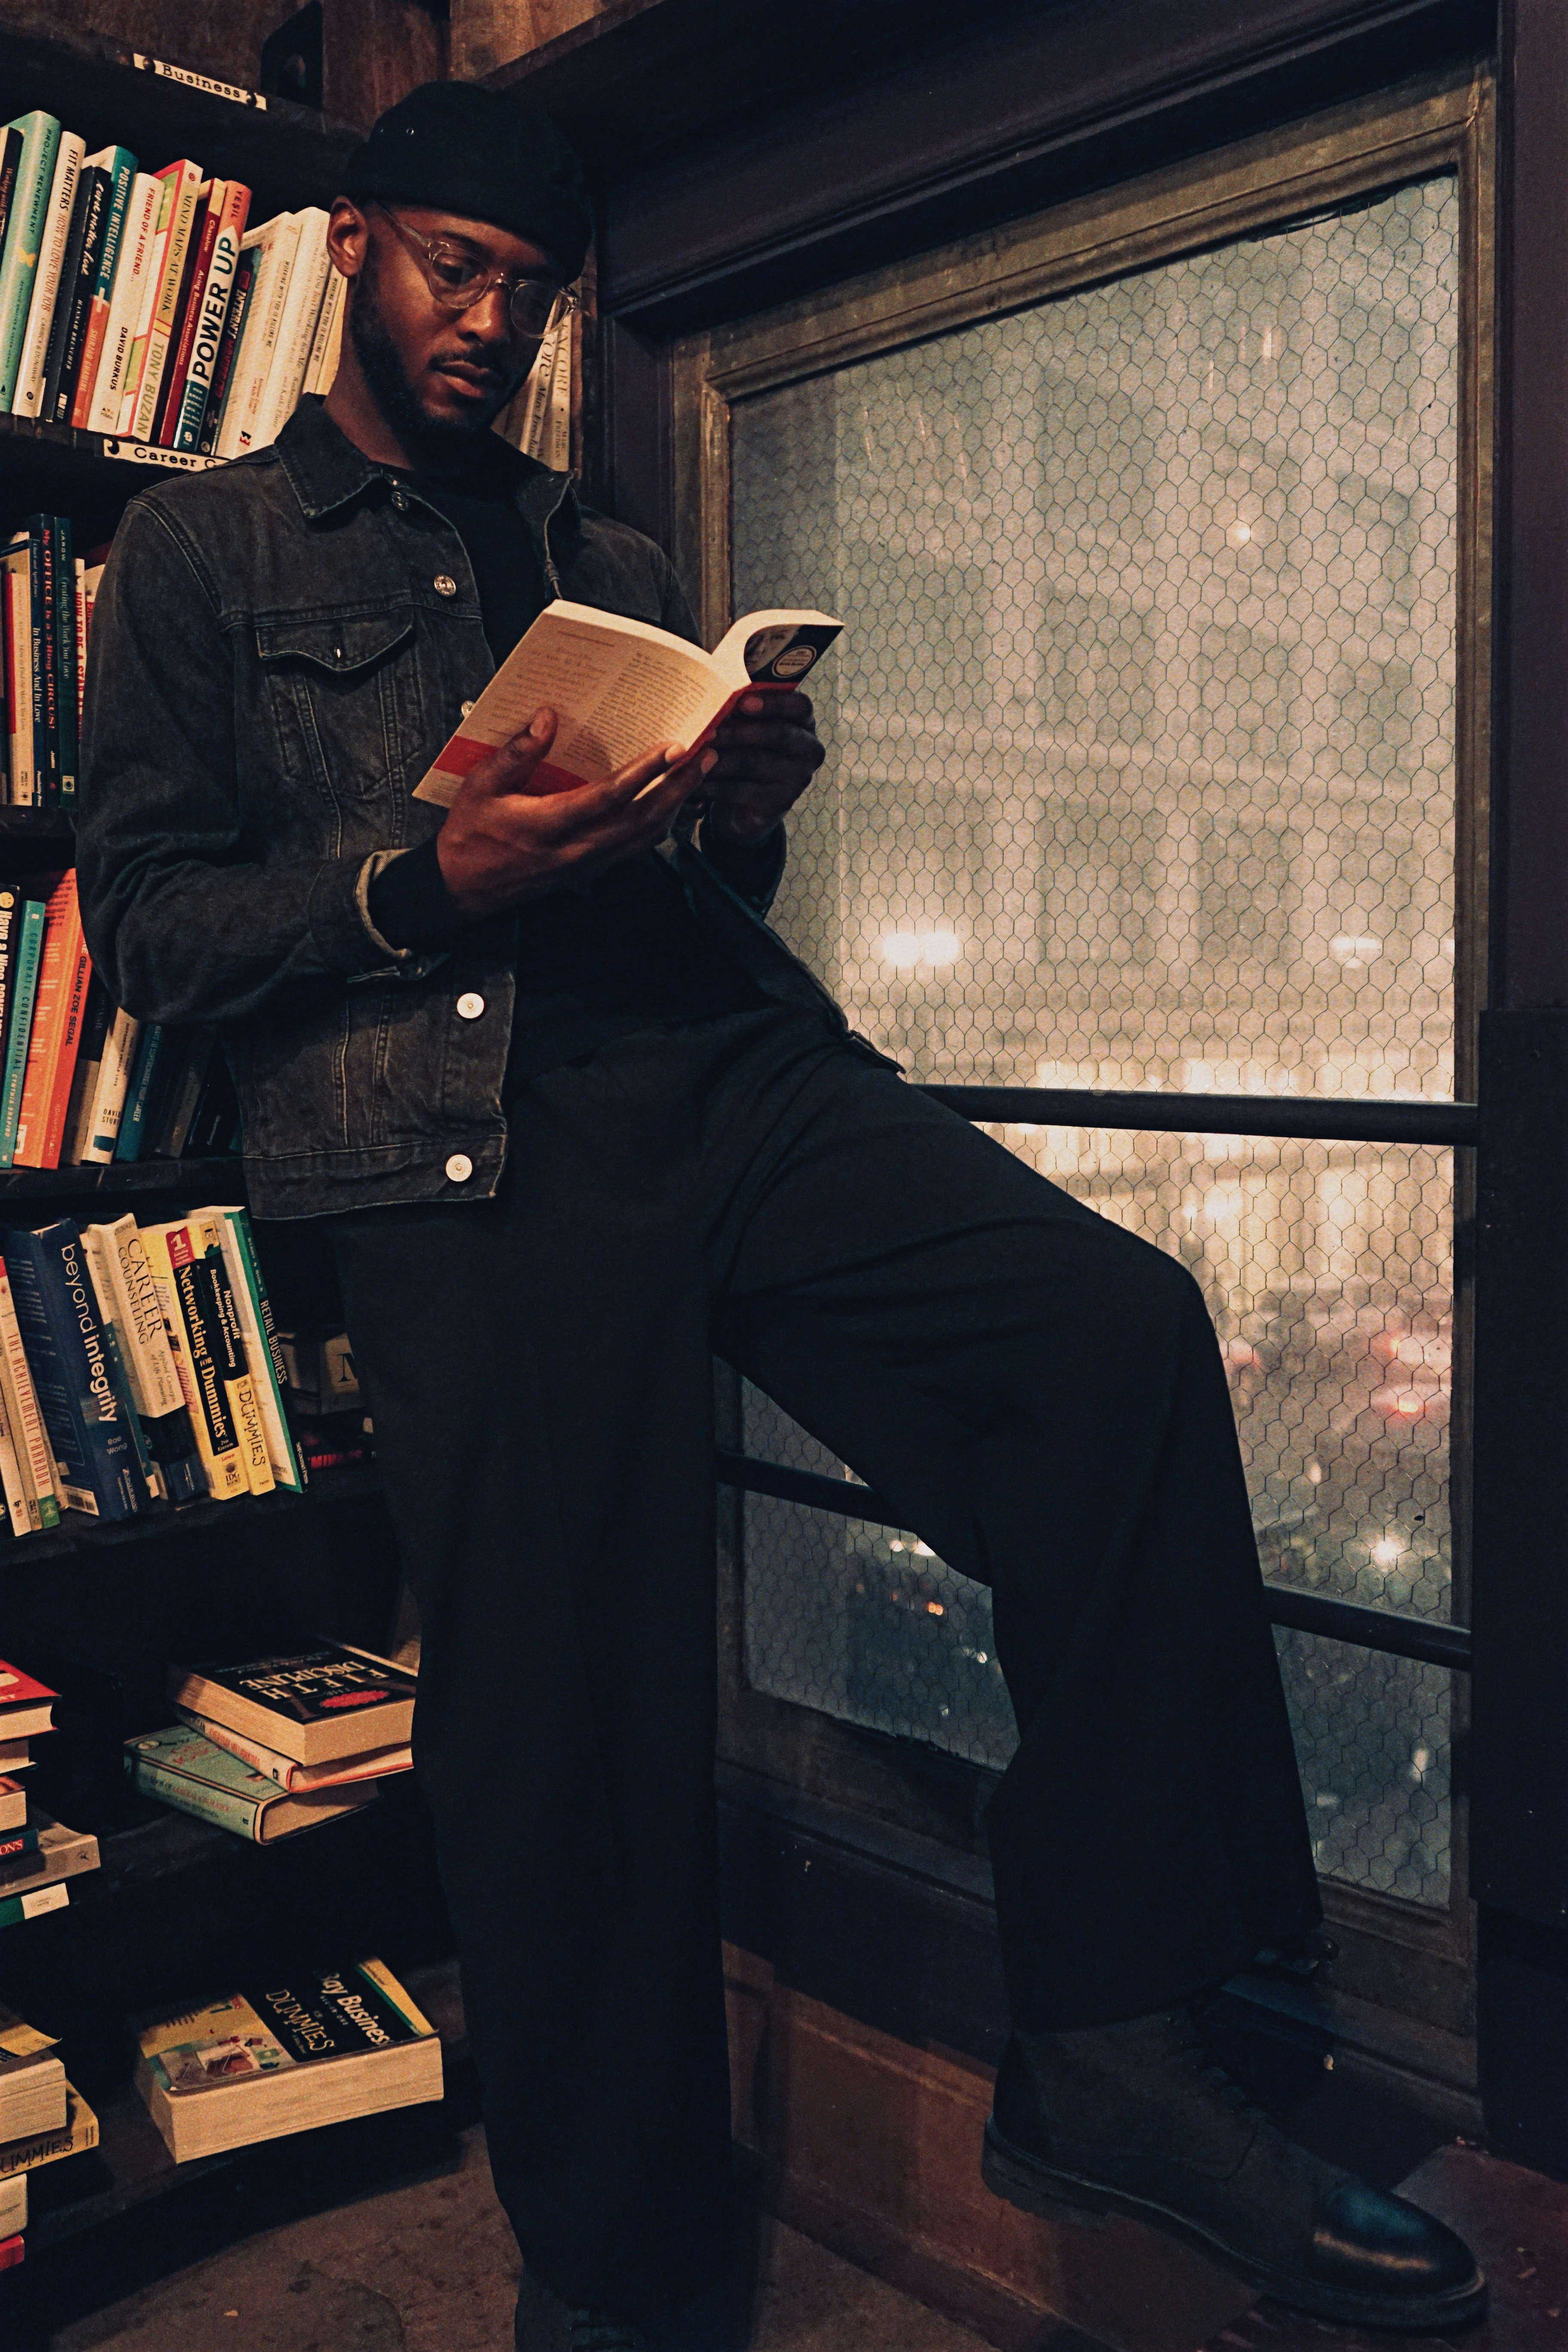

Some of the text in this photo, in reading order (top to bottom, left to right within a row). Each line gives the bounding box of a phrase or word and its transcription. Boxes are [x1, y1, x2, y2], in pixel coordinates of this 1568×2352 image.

[163, 64, 240, 98] Business
[30, 128, 52, 234] PROJECT RENEWMENT
[68, 149, 78, 165] FIT
[59, 166, 75, 210] MATTERS
[143, 187, 155, 220] FRIEND
[52, 235, 64, 247] TO
[54, 213, 67, 236] HOW
[99, 166, 131, 280] POSITIVE INTELLIGENCE
[140, 221, 149, 232] OF
[203, 219, 216, 253] Chasalow
[49, 247, 61, 271] LOVE
[162, 195, 193, 312] MIND MAPS AT WORK
[41, 293, 53, 312] JOB
[46, 271, 58, 294] YOUR
[178, 269, 204, 366] Acing Business Associations
[192, 282, 228, 381] POWER
[213, 237, 236, 275] UP
[110, 326, 128, 390] DAVID BURKUS
[137, 342, 165, 434] TONY BUZAN
[134, 447, 196, 467] Career
[43, 529, 50, 545] My
[43, 550, 52, 605] OFFICE
[59, 576, 70, 679] Creating the Work You Love
[33, 627, 42, 722] In Business And In Love
[46, 673, 55, 728] CIRCUS!
[0, 910, 12, 940] Have
[76, 956, 86, 993] GILLIAN
[13, 932, 38, 1070] CORPORATE CONFIDENTIAL
[71, 994, 80, 1014] ZOE
[65, 1016, 76, 1047] SEGAL
[4, 1073, 18, 1138] CYNTHIA SHAPIRO
[132, 1100, 143, 1122] CAREER
[119, 1247, 149, 1345] COUNSELING
[128, 1239, 162, 1339] CAREER
[223, 1290, 241, 1340] Nonprofit
[7, 1333, 21, 1353] THE
[61, 1243, 117, 1422] beyond integrity
[210, 1269, 225, 1319] Bookkeeping
[222, 1325, 236, 1368] Accounting
[260, 1299, 288, 1385] RETAIL BUSINESS
[179, 1264, 207, 1359] Networking
[201, 1366, 228, 1438] Dummies
[12, 1358, 39, 1432] ACHIEVEMENT
[239, 1389, 266, 1466] DUMMIES
[0, 1840, 23, 1855] ON'S
[265, 1989, 336, 2051] DUMMIES
[0, 2136, 73, 2173] UMMIES
